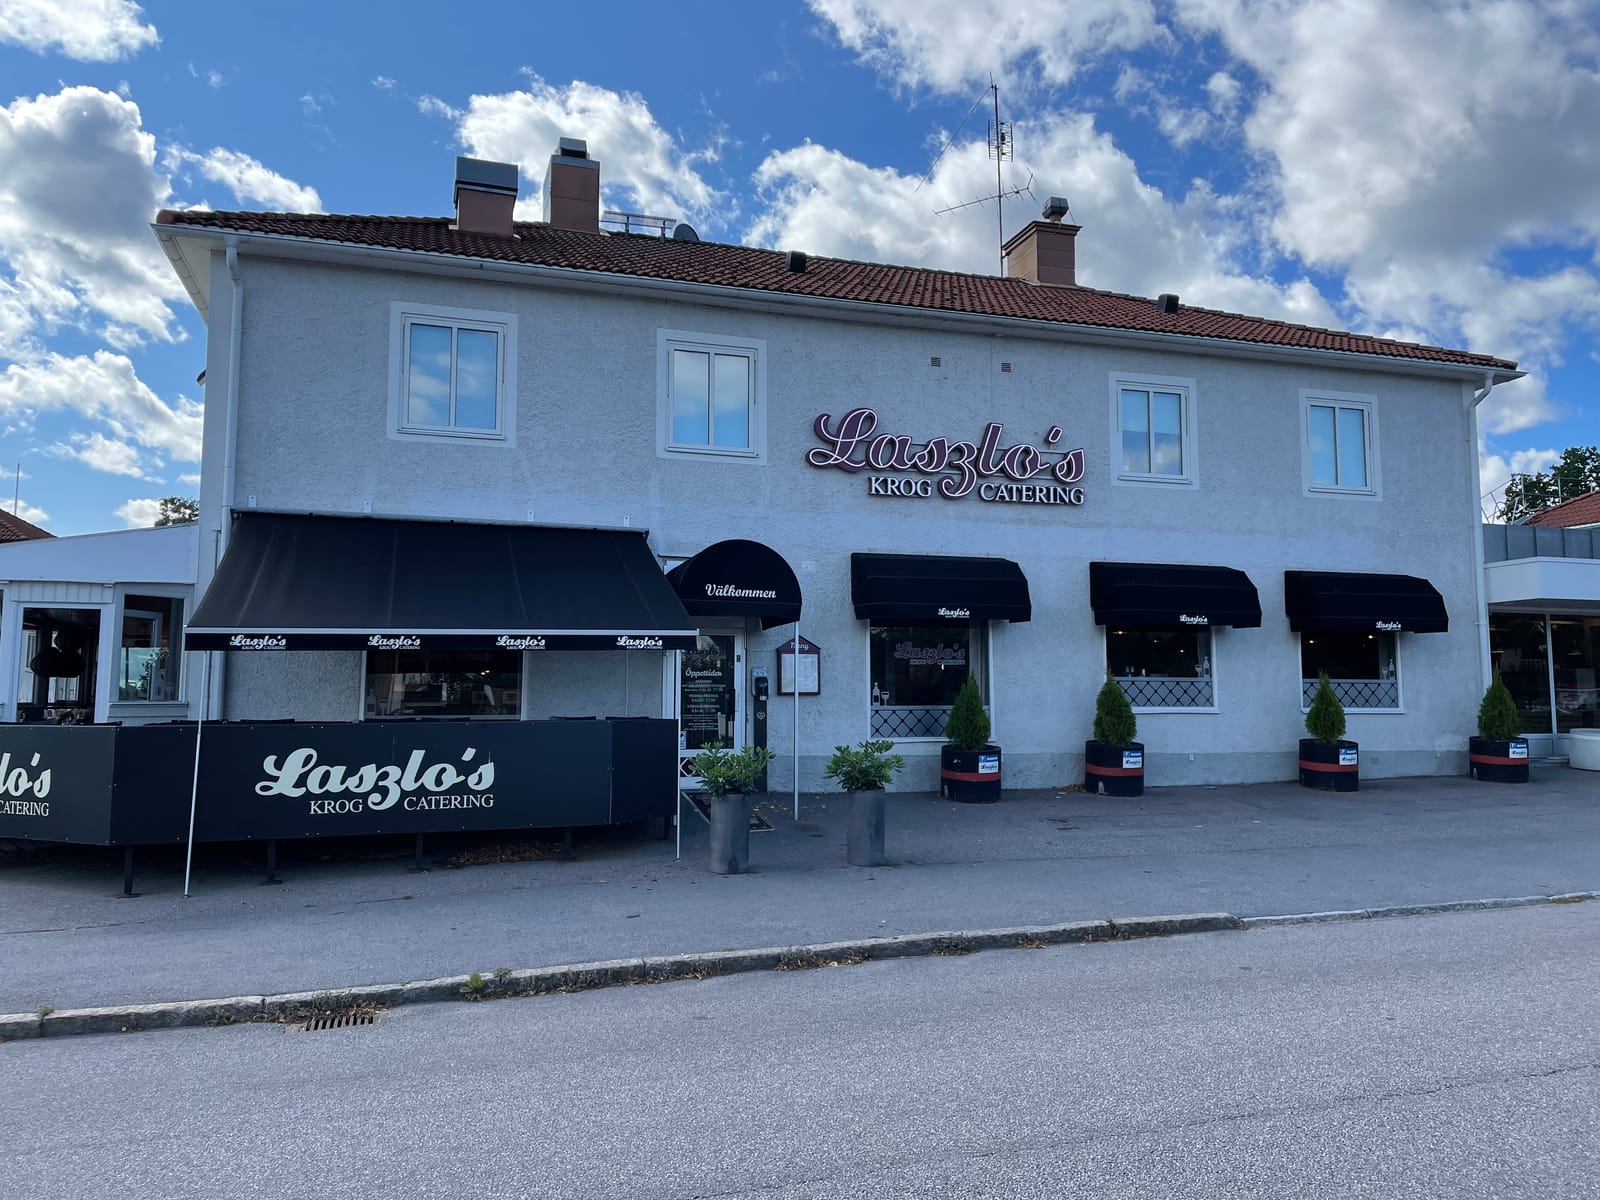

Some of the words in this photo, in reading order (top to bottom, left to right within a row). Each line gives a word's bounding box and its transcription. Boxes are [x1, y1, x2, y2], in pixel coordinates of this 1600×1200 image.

[806, 407, 1085, 497] Laszlo's
[868, 476, 932, 498] KROG
[979, 483, 1085, 505] CATERING
[705, 583, 777, 598] Välkommen
[229, 634, 286, 650] Laszlo's
[367, 634, 421, 650] Laszlo's
[495, 635, 546, 650] Laszlo's
[615, 635, 663, 649] Laszlo's
[255, 747, 495, 811] Laszlo's
[309, 799, 363, 815] KROG
[403, 794, 494, 811] CATERING
